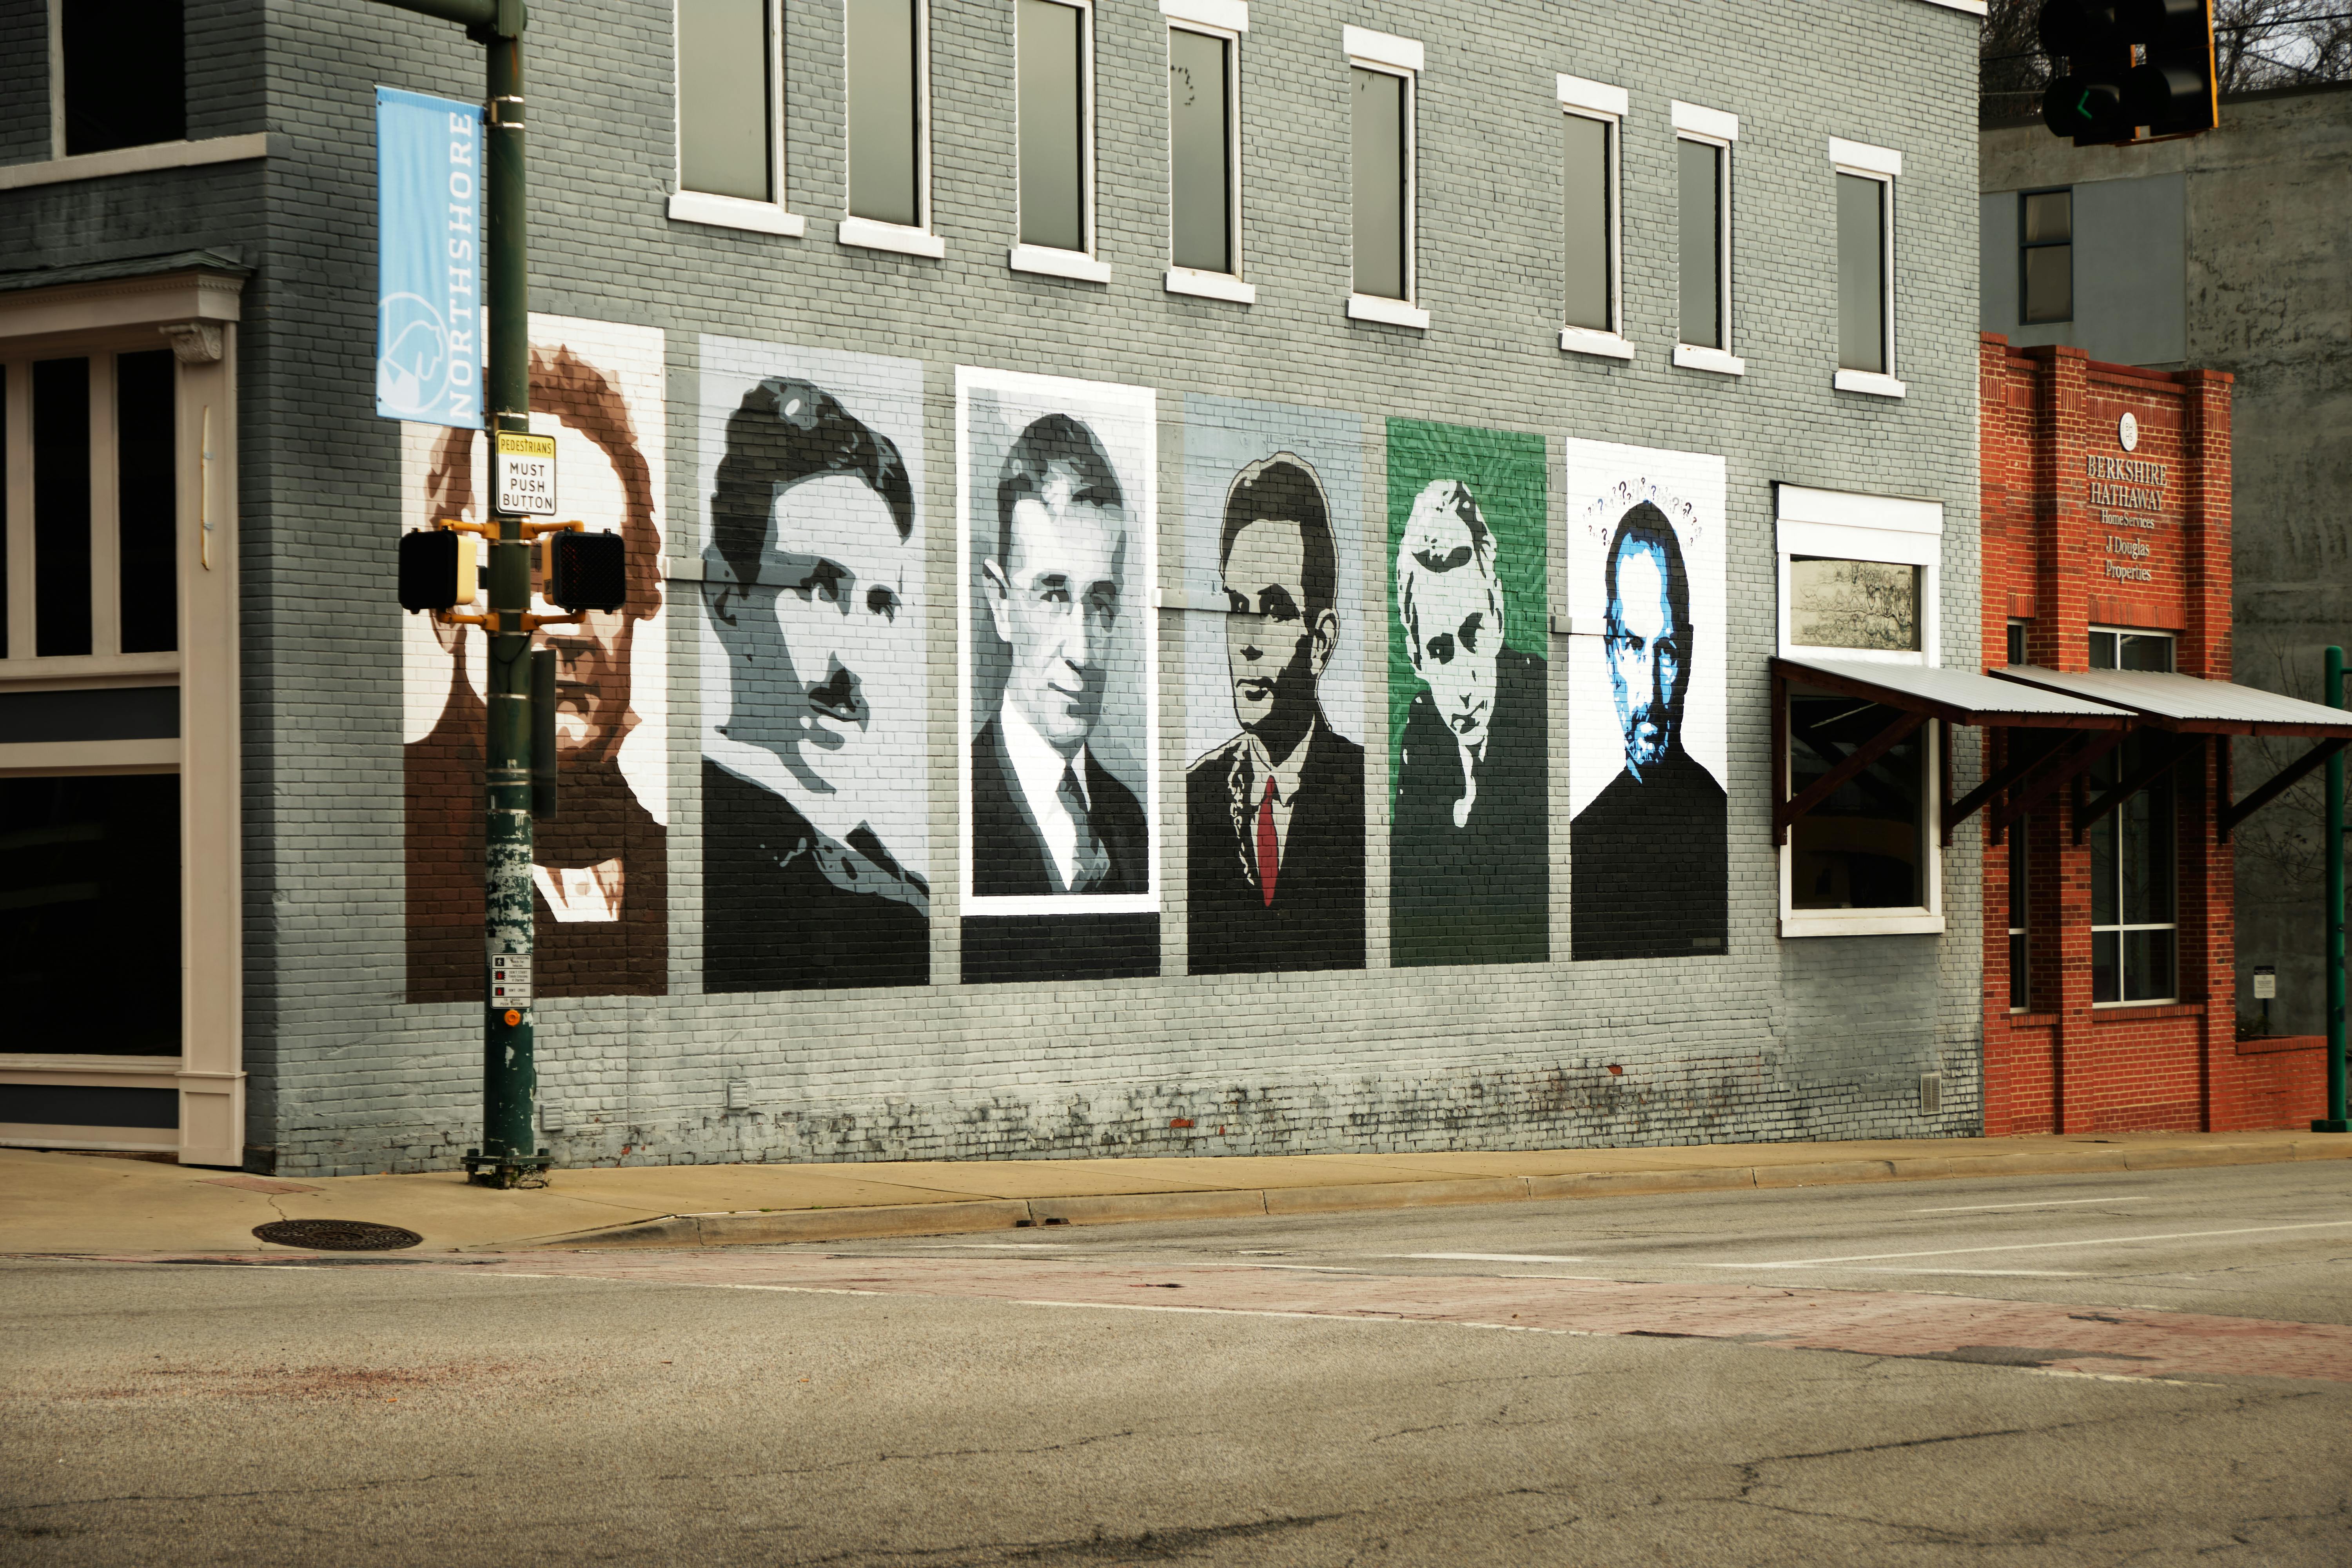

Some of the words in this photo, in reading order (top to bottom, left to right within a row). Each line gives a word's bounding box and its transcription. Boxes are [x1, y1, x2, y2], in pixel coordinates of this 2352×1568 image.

[449, 112, 472, 420] NORTHSHORE
[501, 439, 552, 454] PEDESTRIANS
[510, 462, 544, 476] MUST
[2087, 455, 2168, 486] BERKSHIRE
[511, 478, 544, 493] PUSH
[2090, 482, 2164, 511] HATHAWAY
[503, 494, 552, 509] BUTTON
[2101, 510, 2155, 529] HomeServices
[2106, 535, 2112, 553] J
[2114, 537, 2150, 560] Douglas
[2105, 559, 2151, 584] Properties
